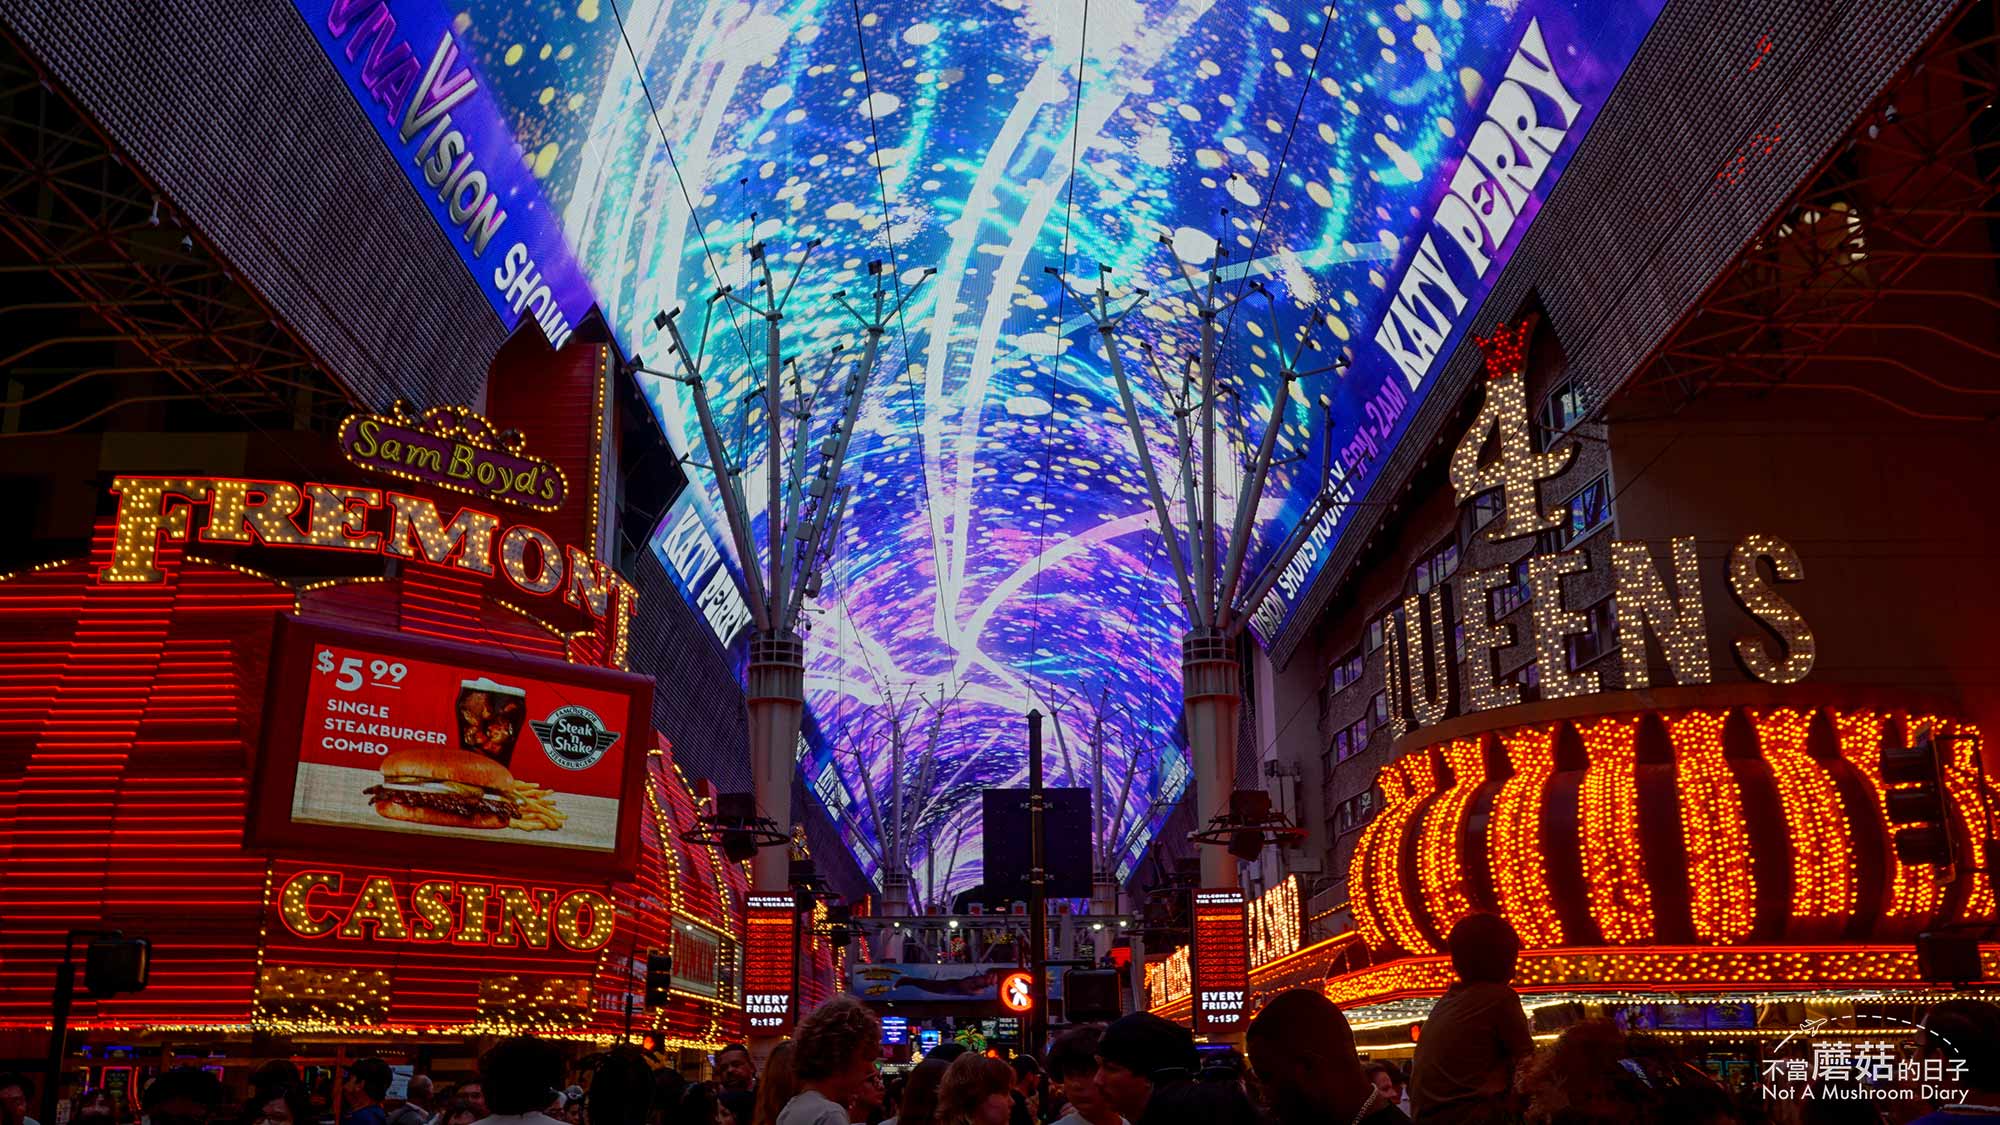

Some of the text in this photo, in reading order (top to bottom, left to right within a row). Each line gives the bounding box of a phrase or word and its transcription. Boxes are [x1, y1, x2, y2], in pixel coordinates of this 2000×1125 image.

[1375, 232, 1468, 392] KATY
[1434, 16, 1582, 279] PERRY
[354, 421, 554, 499] Sam Boyd's
[1450, 373, 1578, 541] 4
[100, 475, 639, 672] FREMONT
[662, 504, 752, 649] KATY PERRY
[1384, 534, 1815, 740] QUEENS
[327, 699, 390, 719] SINGLE
[323, 718, 447, 745] STEAKBURGER
[557, 718, 593, 737] Steak
[321, 736, 389, 756] COMBO
[555, 736, 593, 754] Shake
[278, 869, 616, 952] CASINO
[746, 995, 789, 1004] EVERY
[1201, 991, 1244, 1001] EVERY
[1202, 1001, 1244, 1010] FRIDAY
[746, 1005, 789, 1013] FRIDAY
[1207, 1014, 1240, 1023] 9:15P
[750, 1017, 784, 1026] 9:15P
